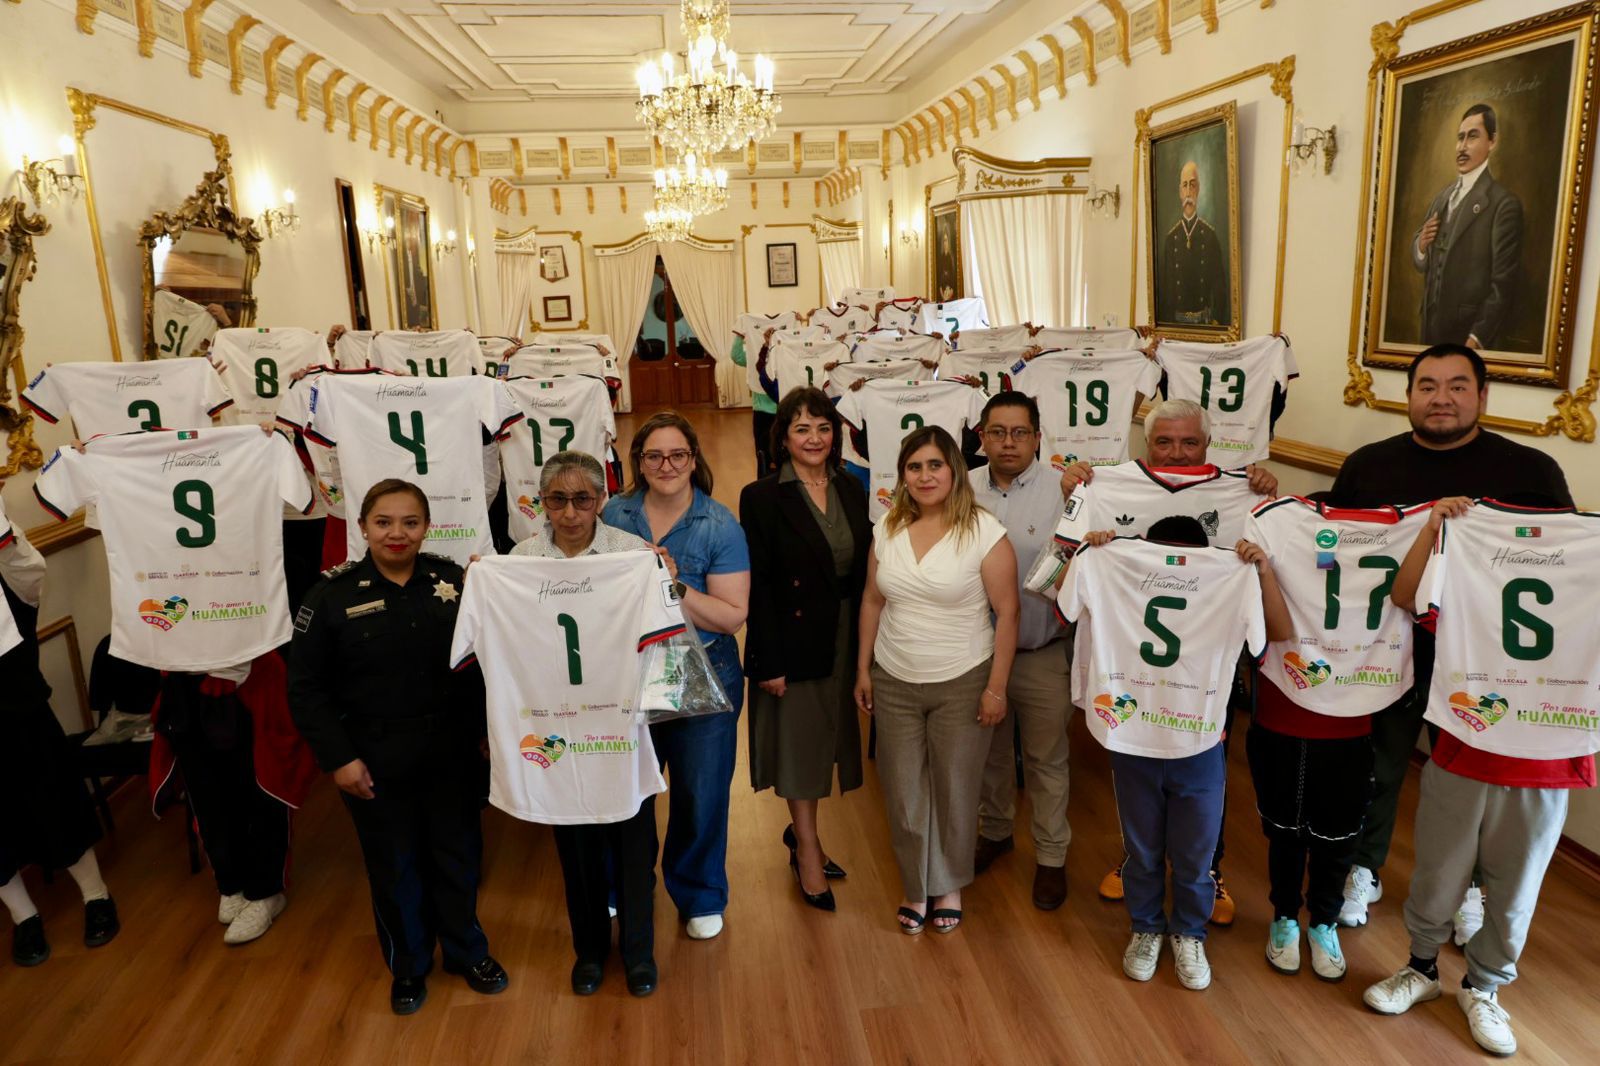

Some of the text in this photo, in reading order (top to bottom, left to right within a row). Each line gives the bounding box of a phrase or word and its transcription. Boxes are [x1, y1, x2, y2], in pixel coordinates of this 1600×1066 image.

[255, 357, 279, 399] 8
[1200, 366, 1246, 412] 13
[376, 383, 427, 401] Huamantla
[1065, 380, 1109, 427] 19
[387, 410, 428, 475] 4
[527, 418, 575, 467] 17
[161, 451, 222, 472] Huamantla
[173, 479, 216, 548] 9
[425, 528, 476, 539] AMANTLA
[1491, 547, 1566, 570] Huamantla
[538, 577, 594, 603] Huamantla
[1141, 572, 1199, 592] Huamantla
[1324, 556, 1399, 630] 17
[192, 605, 267, 620] HUAMANTLA
[1502, 577, 1554, 661] 6
[1140, 595, 1187, 668] 5
[557, 613, 582, 685] 1
[1335, 671, 1405, 685] HUAMANTL
[1141, 711, 1217, 732] HUAMANTLA
[1517, 710, 1600, 729] HUAMANT
[570, 740, 639, 753] HUAMANTLA
